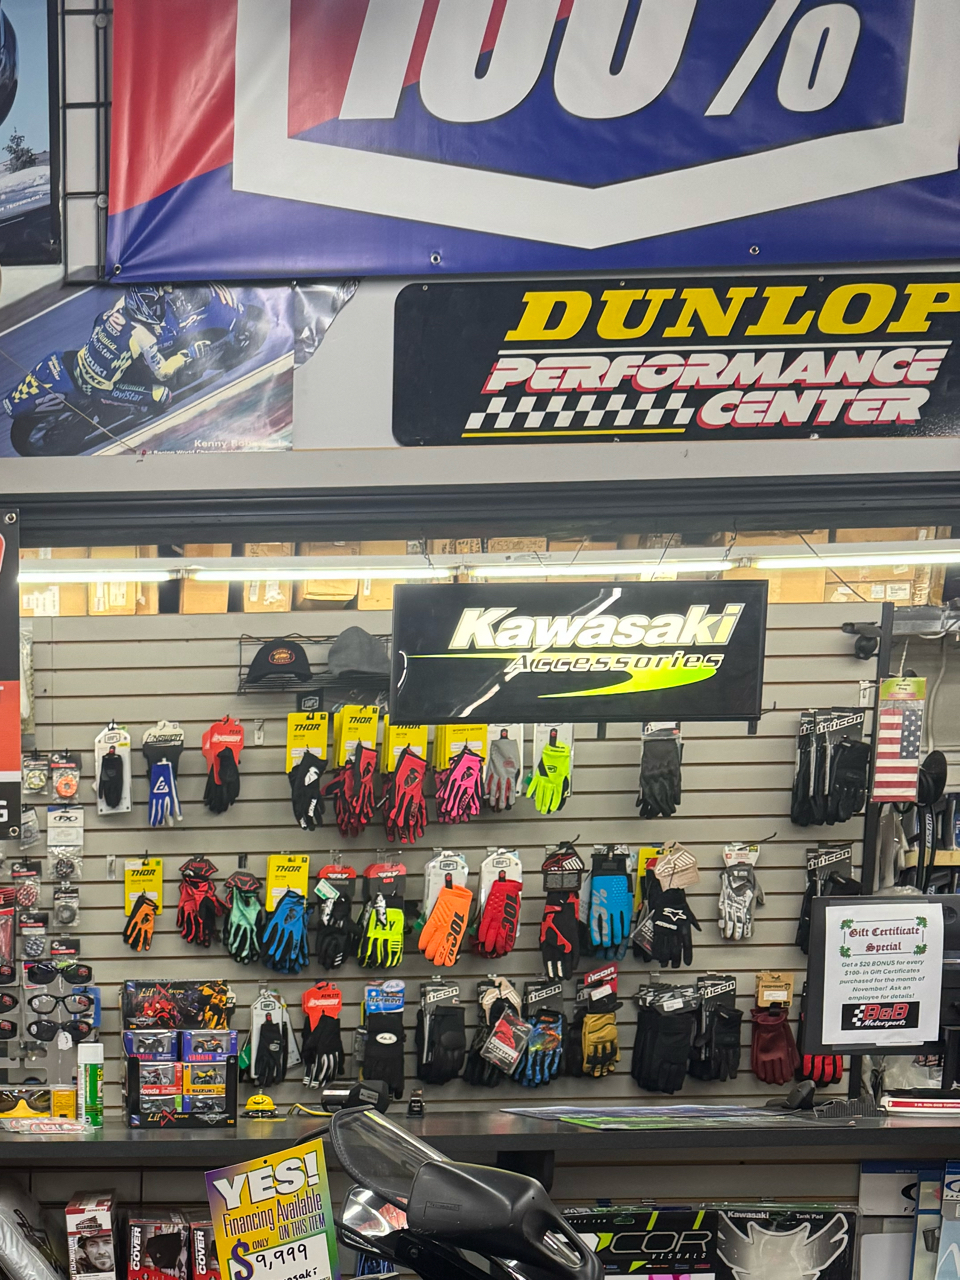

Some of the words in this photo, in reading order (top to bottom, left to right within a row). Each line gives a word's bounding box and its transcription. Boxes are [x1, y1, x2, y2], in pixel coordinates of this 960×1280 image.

[503, 283, 960, 341] DUNLOP
[481, 348, 947, 394] PERFORMANCE
[696, 387, 931, 429] CENTER
[194, 440, 227, 449] Kenny
[448, 602, 746, 649] Kawasaki
[504, 651, 724, 673] Accessories
[293, 723, 321, 731] THOR
[348, 716, 373, 724] THOR
[849, 928, 869, 938] Gift
[872, 926, 920, 936] Certificate
[865, 942, 902, 953] Special
[861, 1019, 906, 1028] Motorsports
[863, 1003, 909, 1020] B&B
[213, 1150, 321, 1211] YES!
[222, 1205, 275, 1238] Financing
[276, 1189, 323, 1224] Available
[728, 1211, 769, 1219] Kawasaki
[278, 1225, 290, 1241] ON
[290, 1218, 307, 1238] THIS
[308, 1212, 326, 1232] ITEM
[133, 1227, 141, 1271] COVER
[198, 1231, 207, 1275] COVER
[252, 1237, 269, 1251] ONLY
[255, 1243, 309, 1270] 9,999
